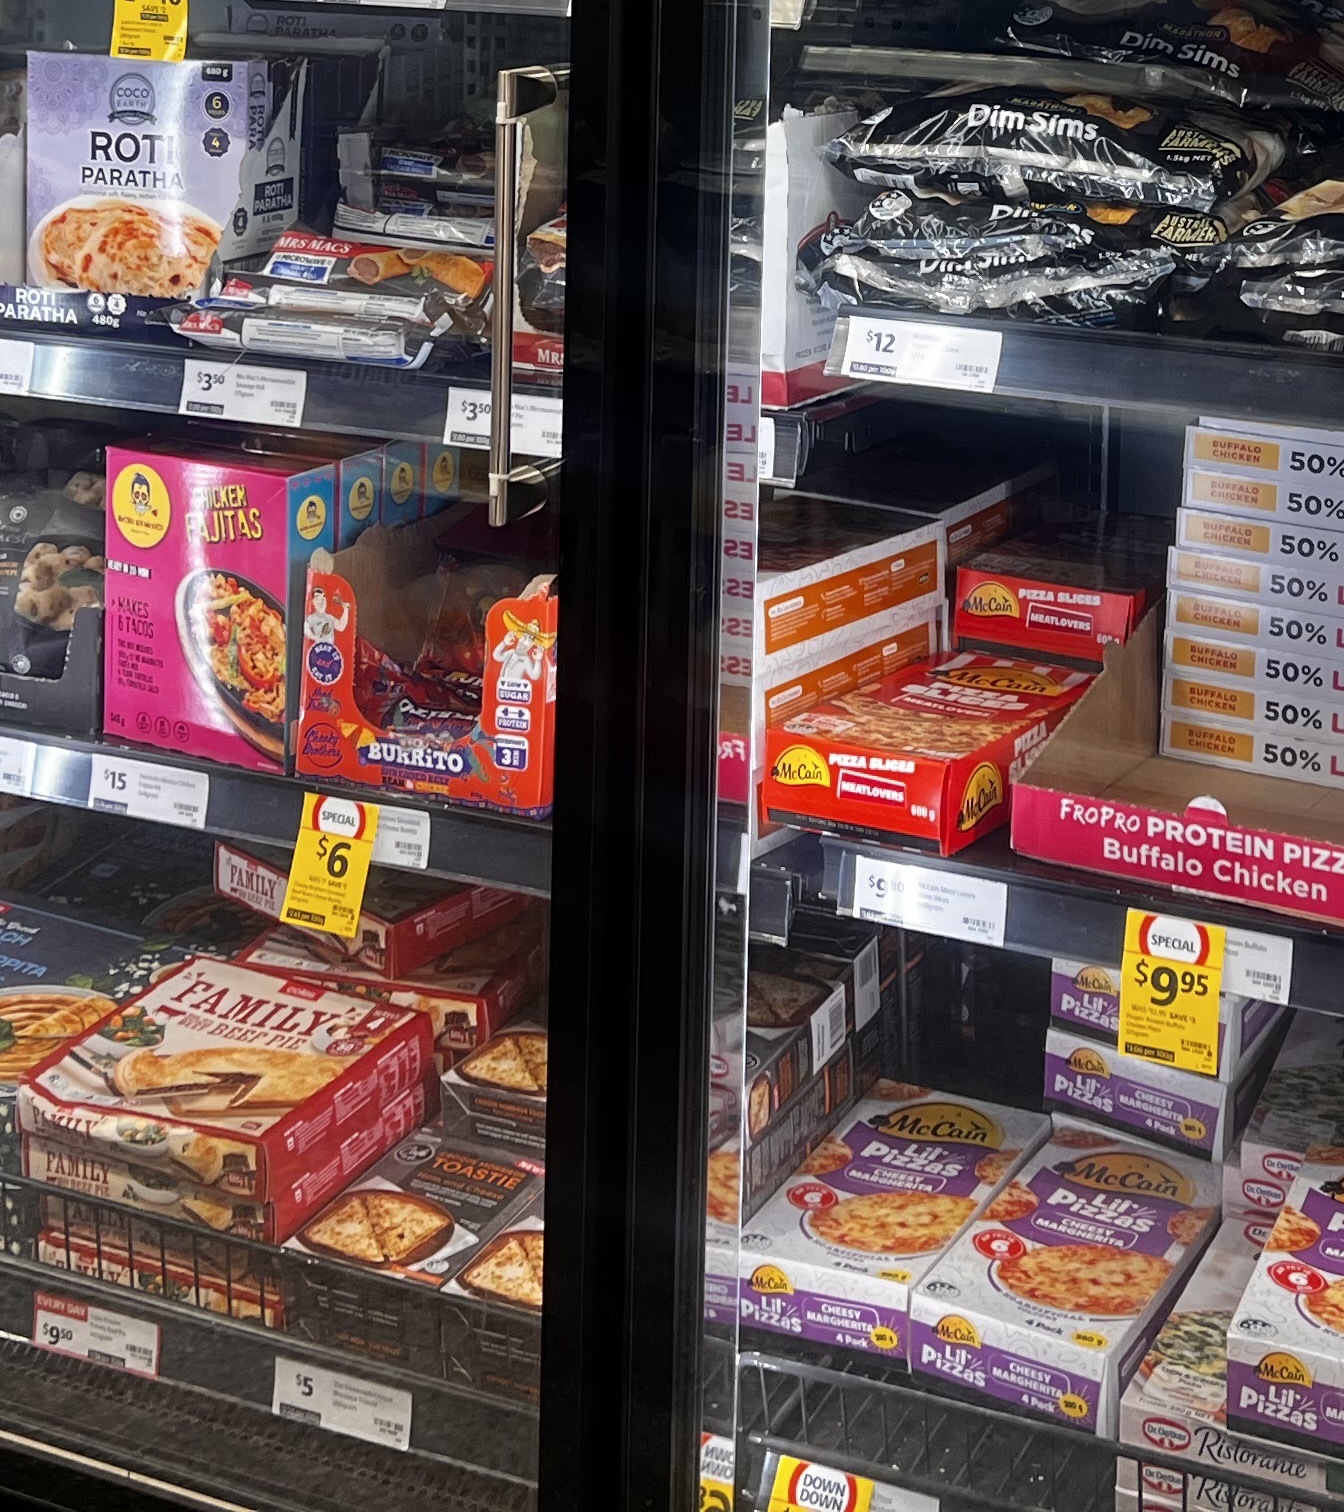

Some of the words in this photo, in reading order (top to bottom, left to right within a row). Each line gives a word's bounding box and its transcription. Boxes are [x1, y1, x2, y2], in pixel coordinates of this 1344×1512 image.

[1119, 31, 1174, 55] Dim
[1175, 38, 1241, 79] Sims
[966, 101, 1025, 133] Dim
[1029, 110, 1098, 141] Sims
[89, 130, 176, 165] ROTI
[81, 166, 185, 191] PARATHA
[278, 236, 306, 250] MRS
[308, 237, 352, 254] MAC'S
[15, 289, 56, 306] ROTI
[91, 313, 120, 328] 480g
[1212, 450, 1261, 464] CHICKEN
[1213, 439, 1262, 454] BUFFALO
[186, 509, 263, 544] FAJITAS
[499, 691, 529, 701] SUGAR
[498, 717, 528, 729] PROTEIN
[829, 753, 866, 769] PIZZA
[869, 756, 915, 774] SLICES
[104, 768, 127, 791] $15
[321, 810, 357, 827] SPECIAL
[1148, 815, 1275, 862] PROTEIN
[316, 835, 349, 879] $6
[1103, 838, 1203, 877] Buffalo
[1213, 860, 1327, 903] Chicken
[1150, 933, 1197, 953] SPECIAL
[170, 981, 334, 1038] FAMILY
[432, 1157, 528, 1190] TOASTIE
